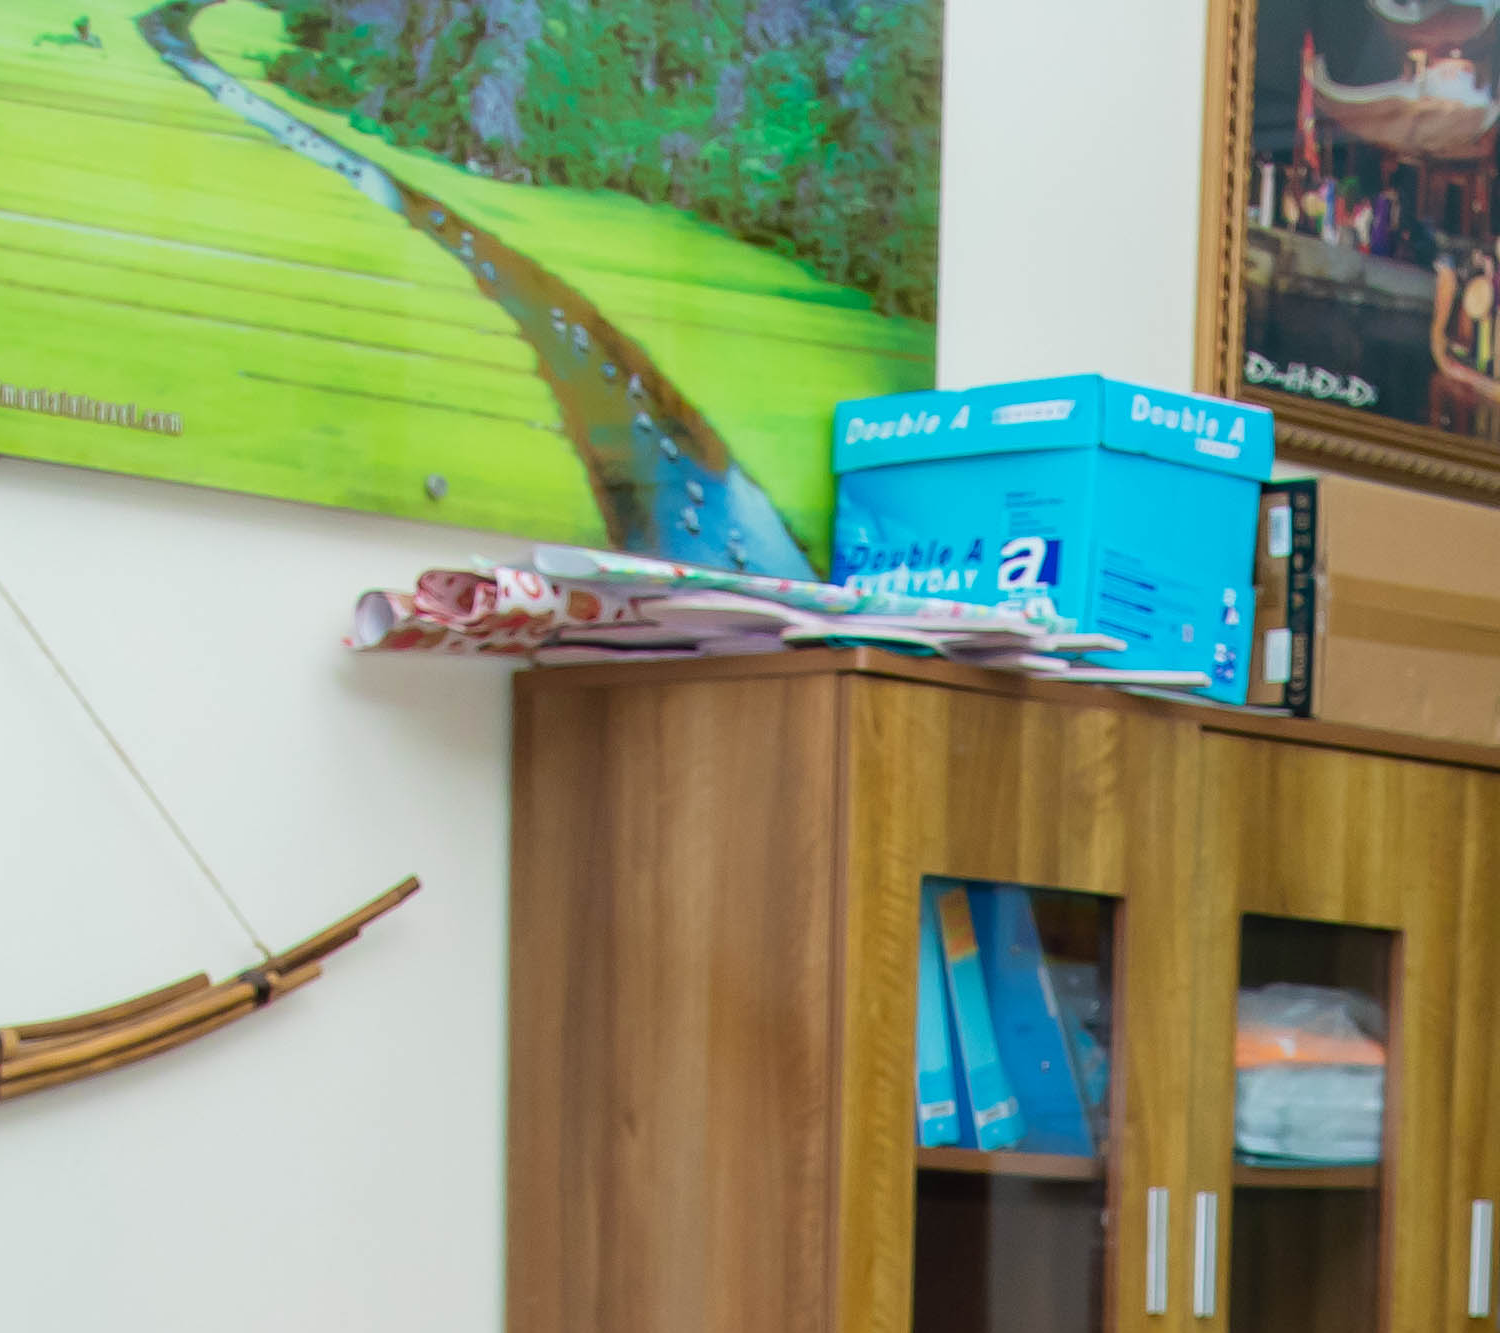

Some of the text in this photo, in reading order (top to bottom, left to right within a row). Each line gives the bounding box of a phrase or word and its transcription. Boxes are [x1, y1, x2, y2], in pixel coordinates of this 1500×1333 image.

[845, 412, 941, 445] Double
[949, 404, 970, 430] A
[1131, 393, 1245, 443] Double A
[847, 538, 983, 570] Double A
